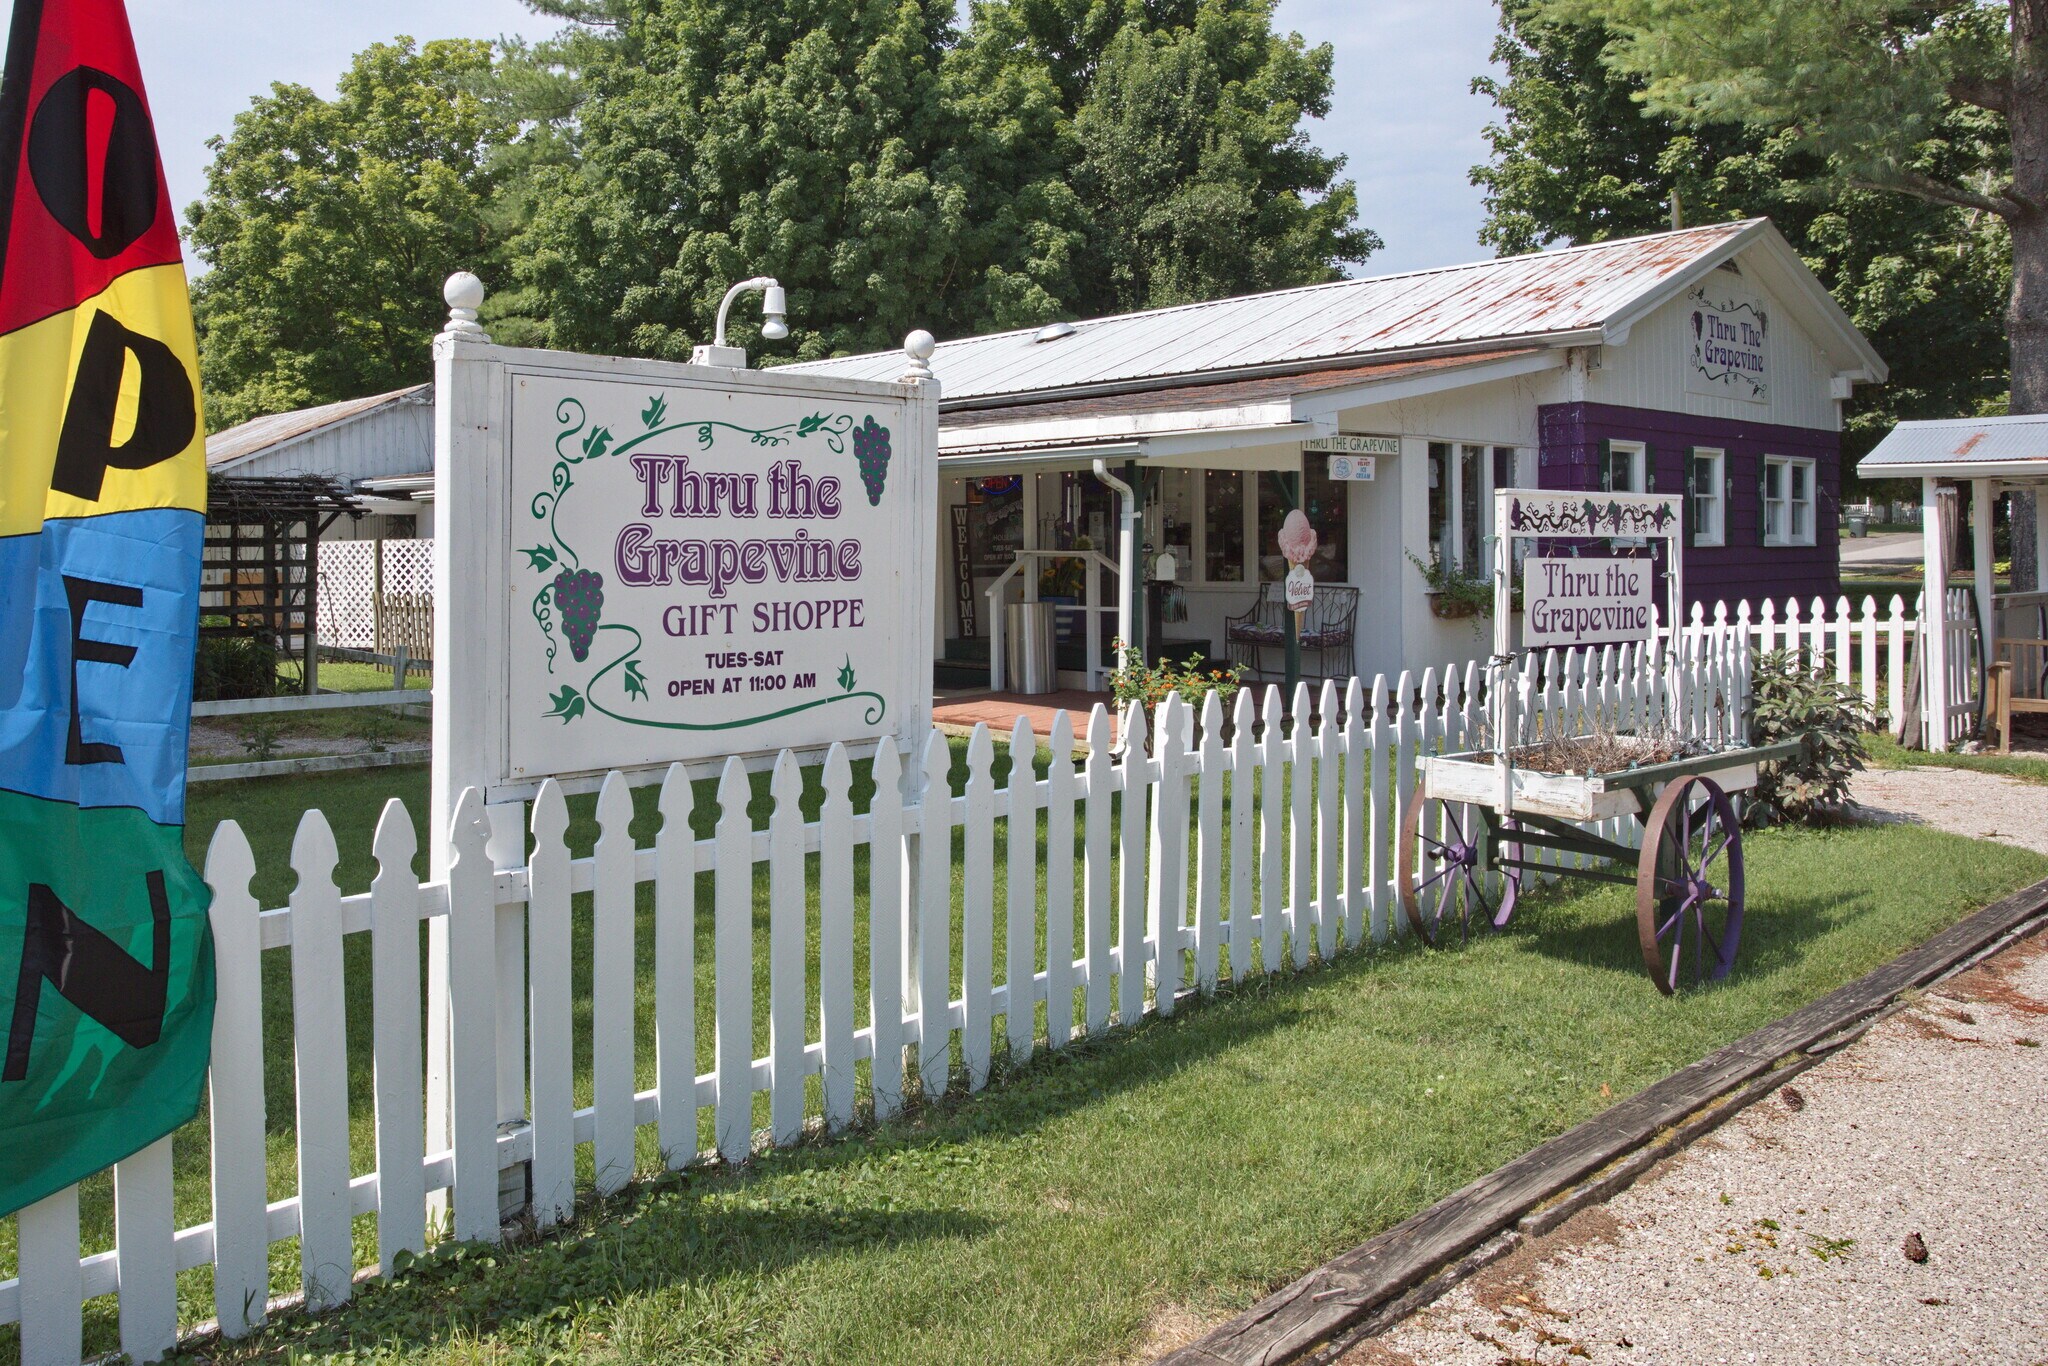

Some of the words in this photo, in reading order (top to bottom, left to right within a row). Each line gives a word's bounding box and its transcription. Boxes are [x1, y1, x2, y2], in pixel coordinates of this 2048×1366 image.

[1707, 315, 1736, 342] Thru
[1741, 322, 1761, 347] The
[1705, 340, 1763, 372] Grapevine
[1331, 437, 1347, 450] THE
[1350, 438, 1398, 453] GRAPEVINE
[630, 454, 758, 518] Thru
[767, 460, 842, 519] the
[4, 65, 197, 1081] OPEN
[615, 523, 862, 598] Grapevine
[953, 508, 973, 636] WELCOME
[1288, 580, 1312, 596] Velvet
[1542, 563, 1600, 597] Thru
[1605, 564, 1639, 596] the
[662, 603, 738, 637] GIFT
[752, 599, 865, 633] SHOPPE
[1532, 599, 1647, 640] Grapevine
[705, 650, 784, 669] TUES-SAT
[667, 678, 715, 697] OPEN
[722, 677, 742, 694] AT
[749, 674, 786, 692] 11:00
[793, 673, 816, 689] AM
